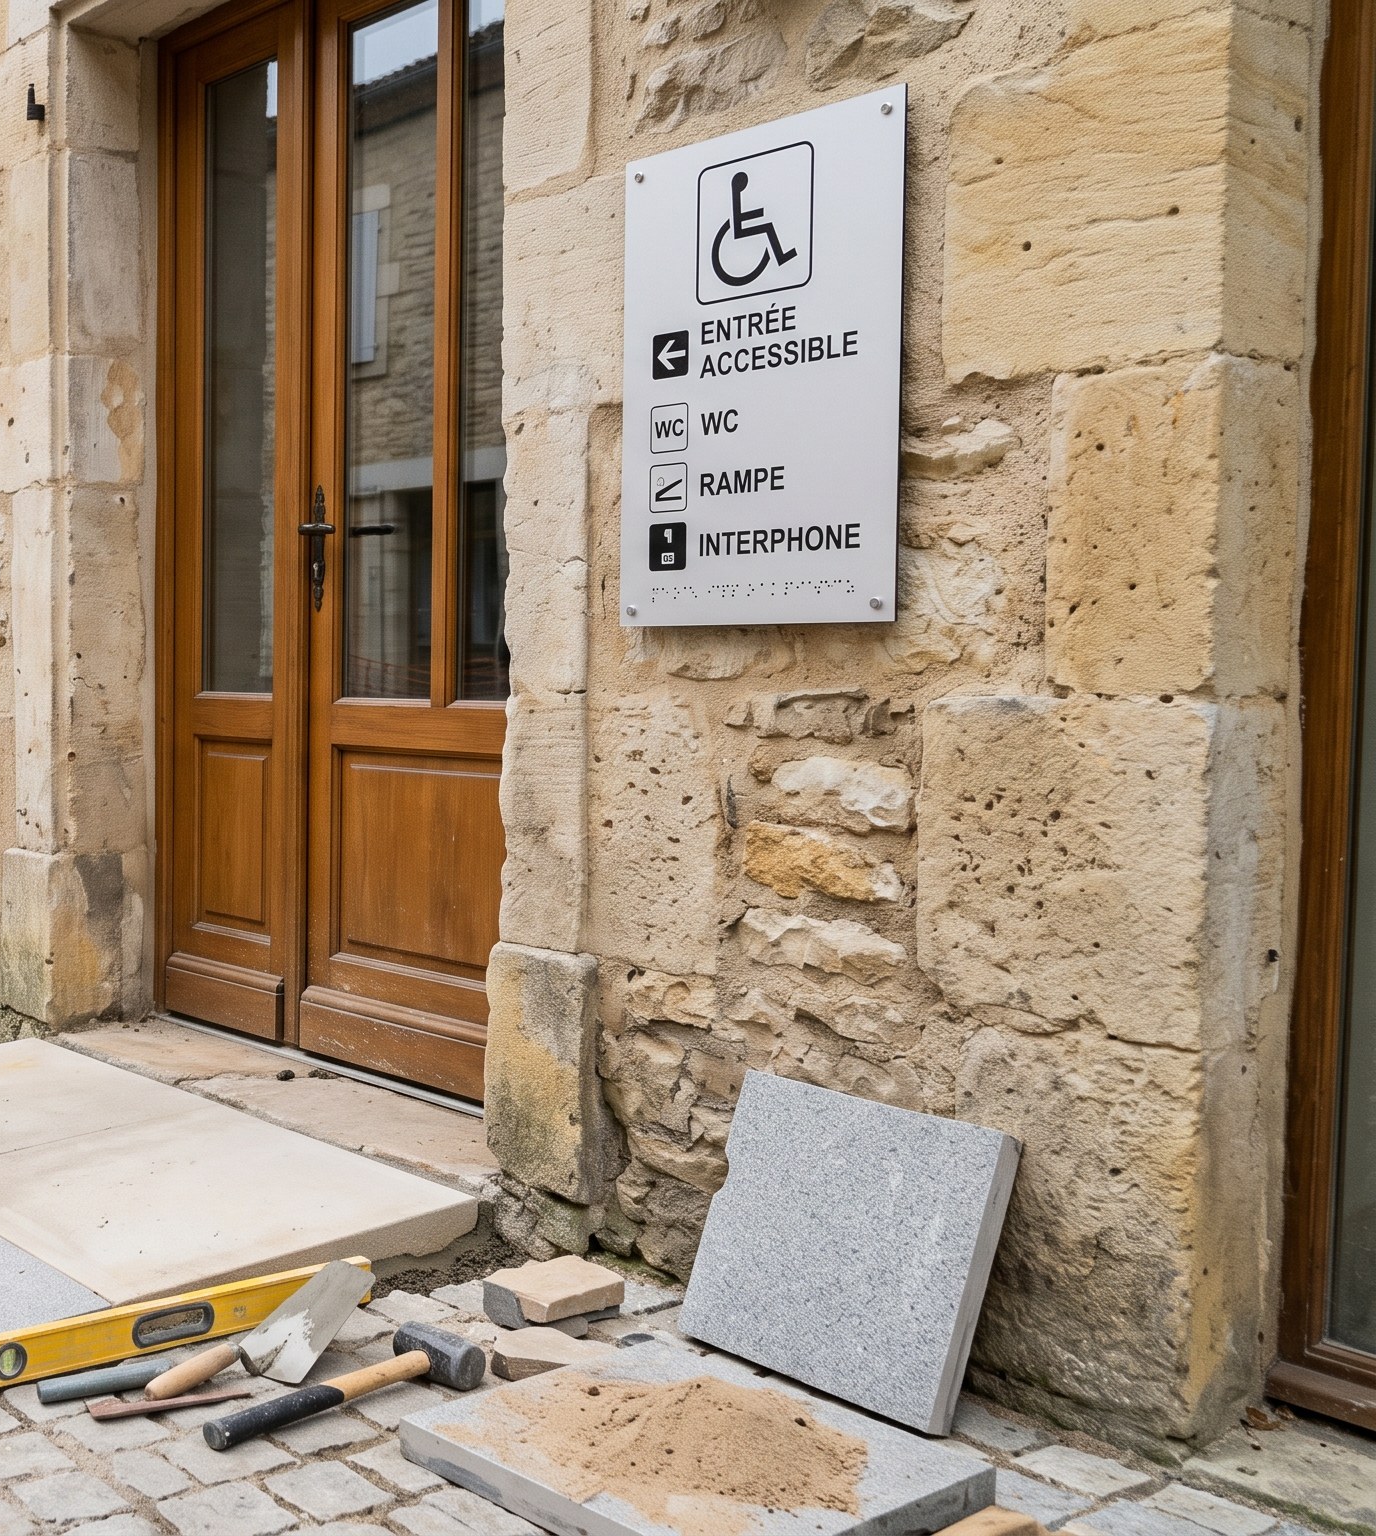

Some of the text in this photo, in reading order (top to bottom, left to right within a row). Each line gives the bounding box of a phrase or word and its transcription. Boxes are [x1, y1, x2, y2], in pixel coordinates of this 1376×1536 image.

[700, 302, 797, 346] ENTRÉE
[699, 330, 858, 379] ACCESSIBLE
[654, 418, 685, 439] WC
[700, 408, 739, 436] WC
[700, 465, 785, 497] RAMPE
[699, 522, 861, 557] INTERPHONE
